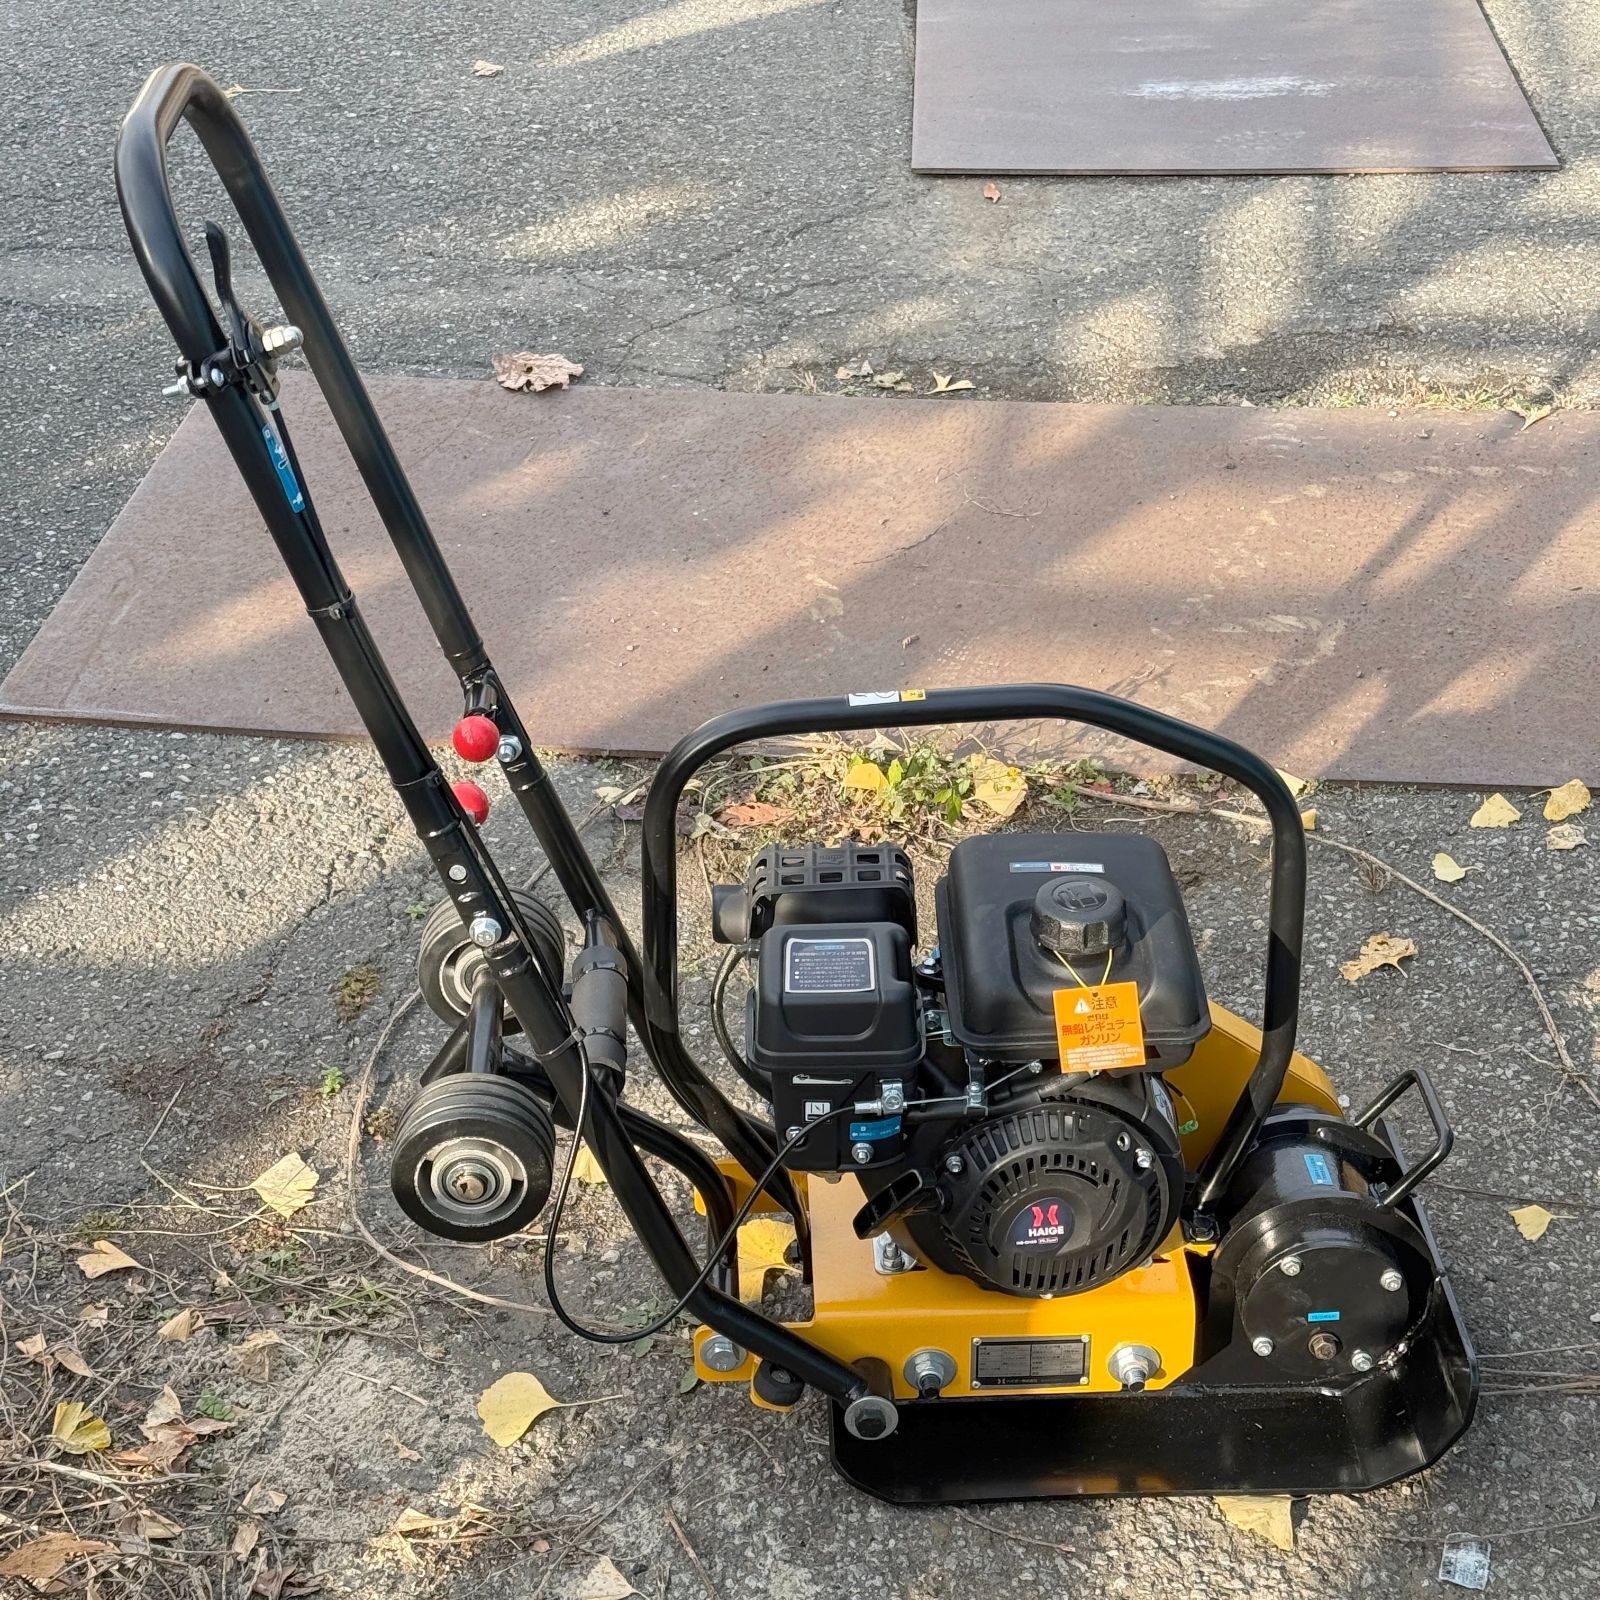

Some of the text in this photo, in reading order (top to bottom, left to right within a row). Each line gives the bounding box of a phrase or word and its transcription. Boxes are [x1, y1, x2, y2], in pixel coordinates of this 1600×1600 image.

[1091, 996, 1118, 1010] 注意
[1062, 1019, 1137, 1036] 無鉛レギュラー
[1079, 1033, 1121, 1046] ガソリン
[1028, 1225, 1065, 1238] HAIGE
